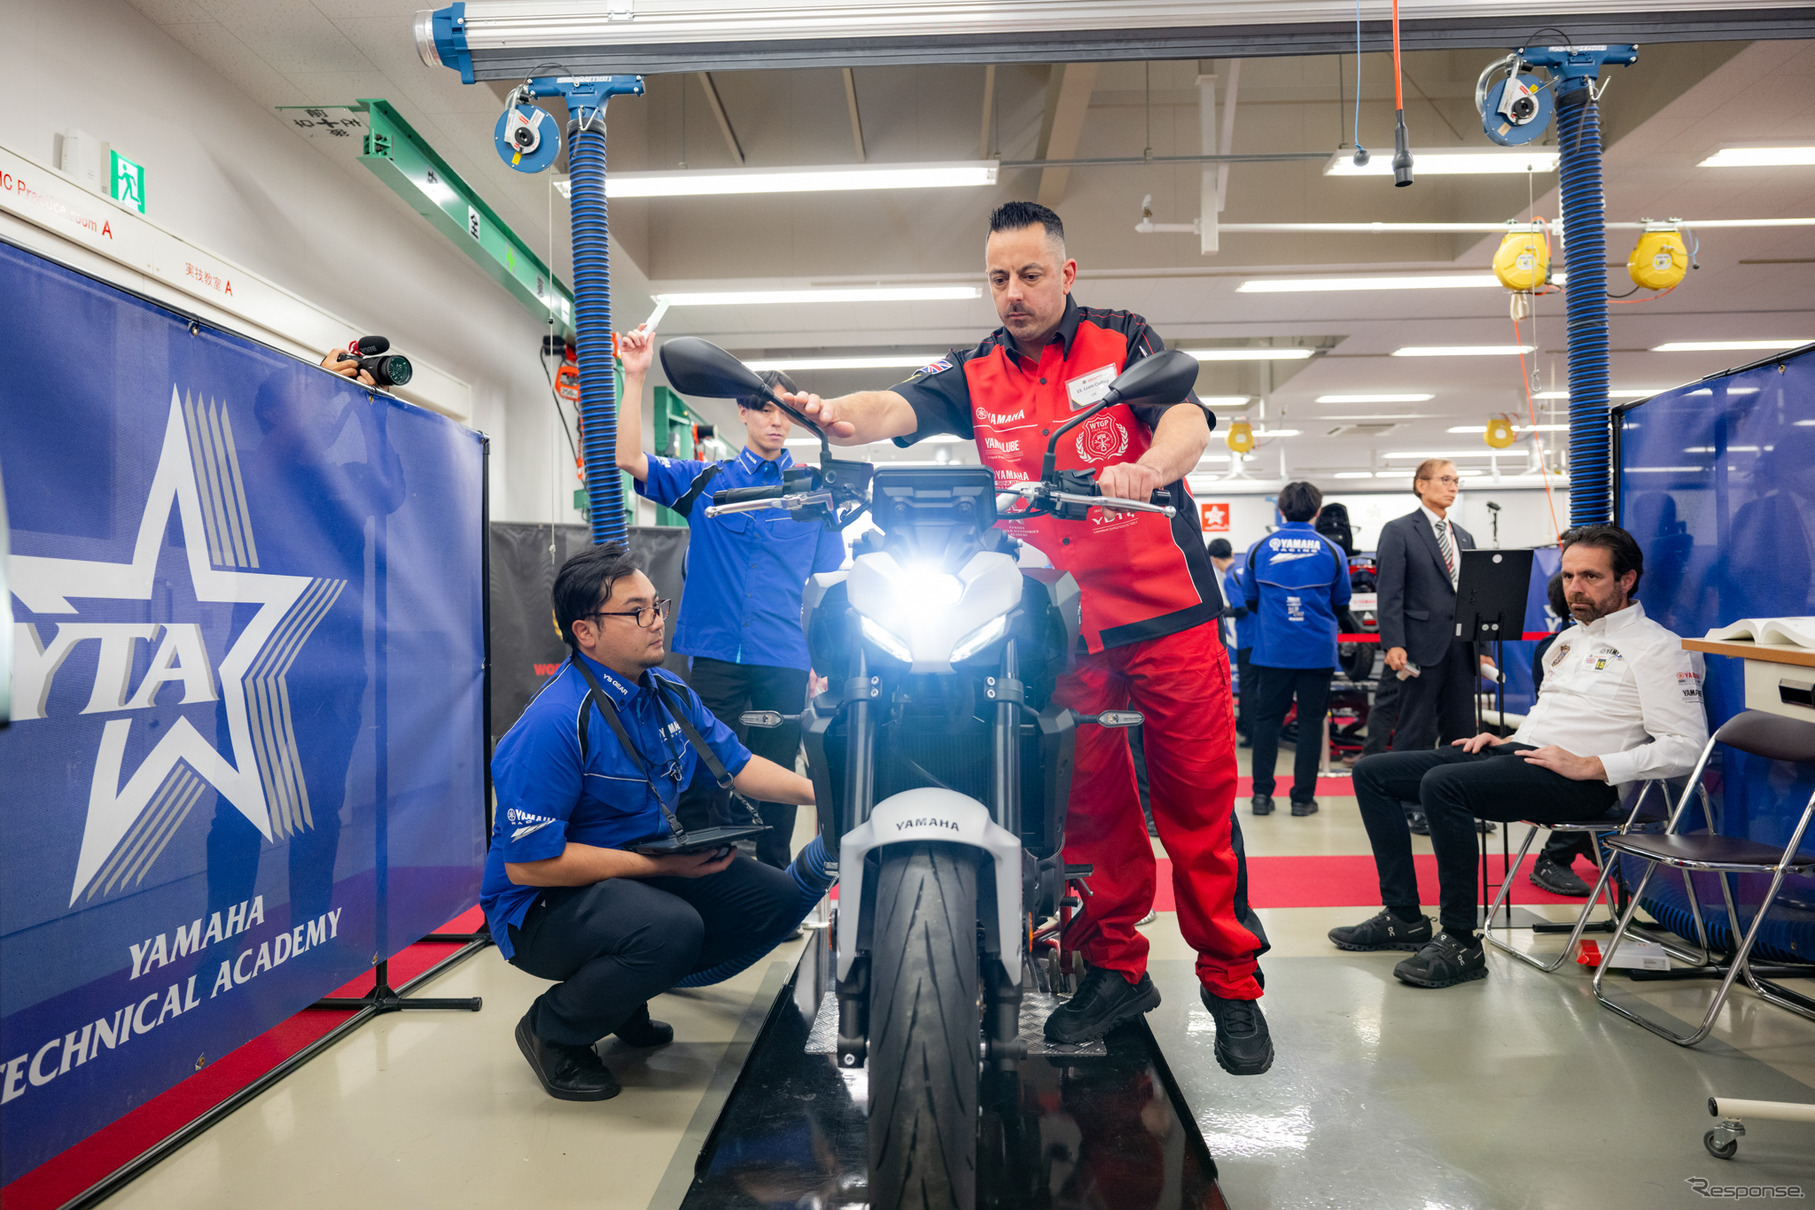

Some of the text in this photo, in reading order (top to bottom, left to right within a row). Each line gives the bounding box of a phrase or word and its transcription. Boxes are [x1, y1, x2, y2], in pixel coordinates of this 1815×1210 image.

[0, 171, 12, 191] C
[101, 219, 113, 240] A
[225, 280, 233, 297] A
[986, 409, 1025, 425] YAMAHA
[1089, 420, 1109, 430] WTGP
[995, 470, 1030, 481] YAMAHA
[1281, 538, 1321, 550] YAMAHA
[10, 622, 220, 722] YTA
[612, 680, 629, 696] GEAR
[896, 817, 959, 832] YAMAHA
[129, 895, 265, 981] YAMAHA
[210, 907, 342, 999] ACADEMY
